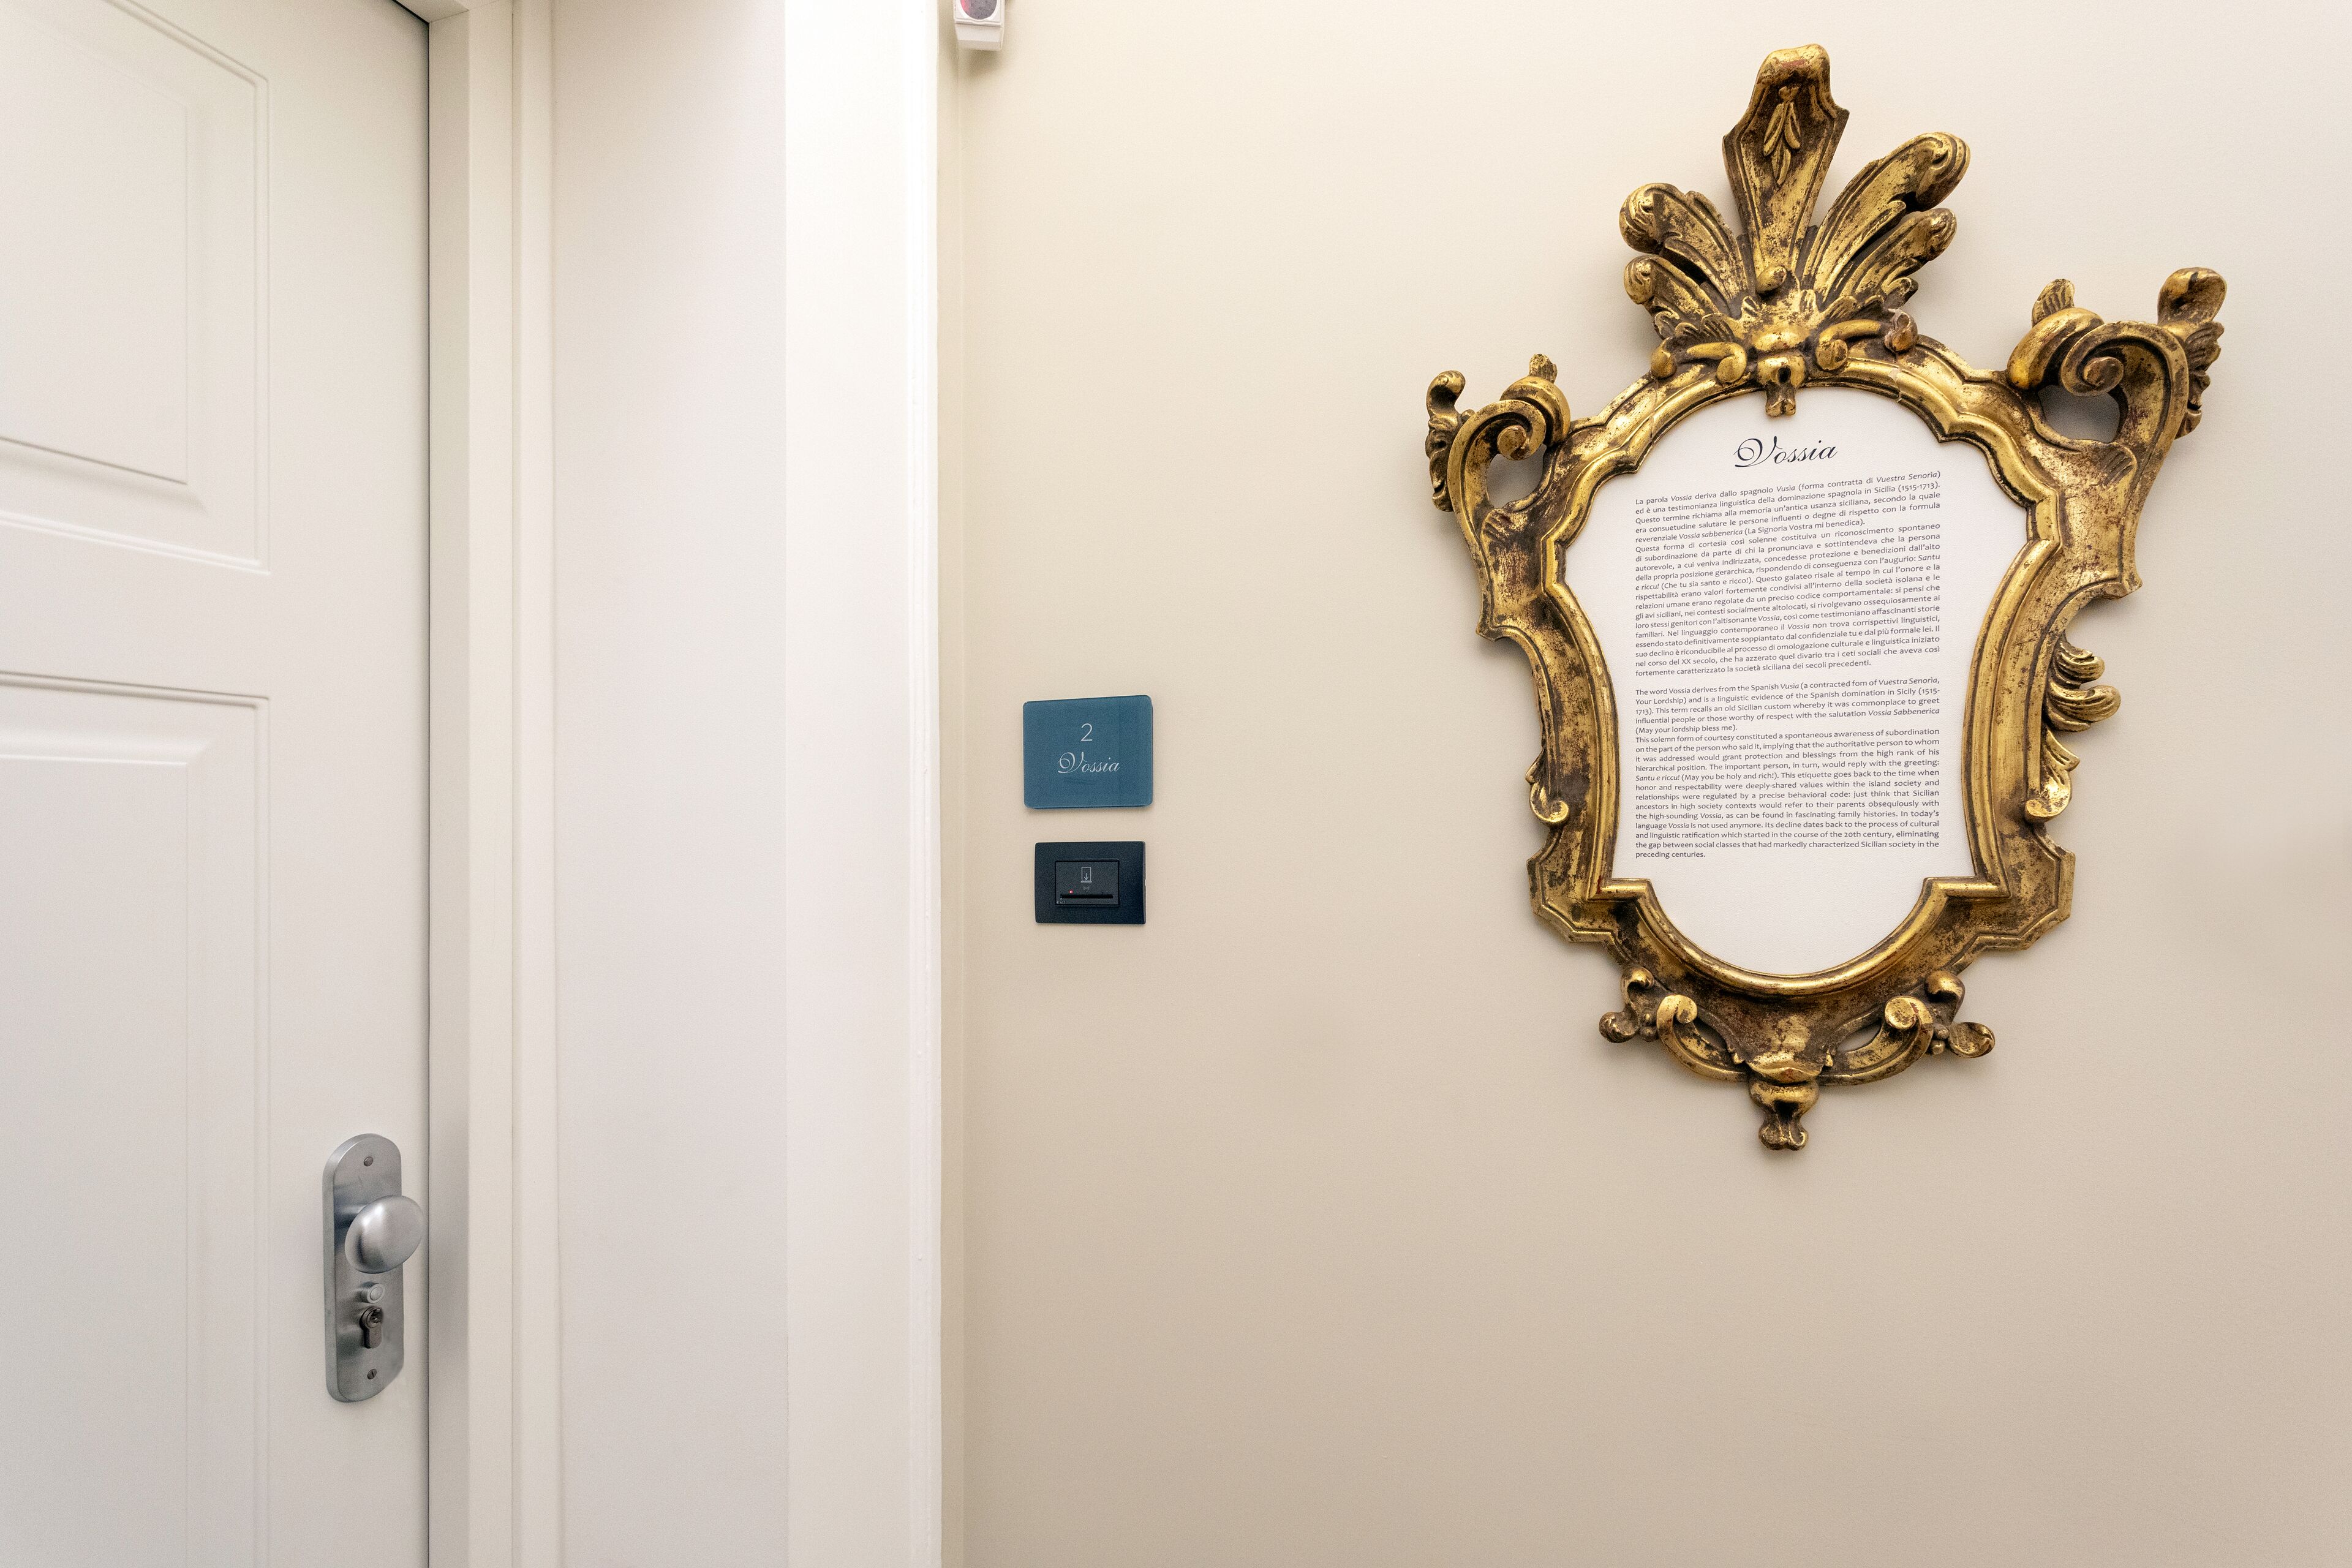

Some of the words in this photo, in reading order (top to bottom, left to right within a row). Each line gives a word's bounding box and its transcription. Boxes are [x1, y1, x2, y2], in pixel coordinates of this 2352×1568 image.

[1733, 435, 1838, 469] Vossia
[1646, 496, 1668, 505] parola
[1740, 487, 1773, 496] spagnolo
[1668, 503, 1717, 511] testimonianza
[1719, 499, 1755, 508] linguistica
[1777, 493, 1825, 502] dominazione
[1828, 489, 1861, 498] spagnola
[1898, 481, 1940, 492] (1515-1713).
[1635, 534, 1677, 543] reverenziale
[1757, 525, 1787, 534] Signoria
[1825, 518, 1864, 527] benedica).
[1834, 527, 1894, 537] riconoscimento
[1898, 524, 1940, 533] spontaneo
[1653, 572, 1678, 581] propria
[1715, 568, 1754, 577] gerarchica,
[1756, 564, 1802, 573] rispondendo
[1635, 592, 1678, 601] rispettabilità
[1681, 628, 1717, 637] linguaggio
[1852, 617, 1898, 626] corrispettivi
[1901, 615, 1940, 624] linguistici,
[1828, 659, 1871, 669] precedenti.
[1080, 723, 1093, 742] 2
[1058, 752, 1120, 774] Vossia
